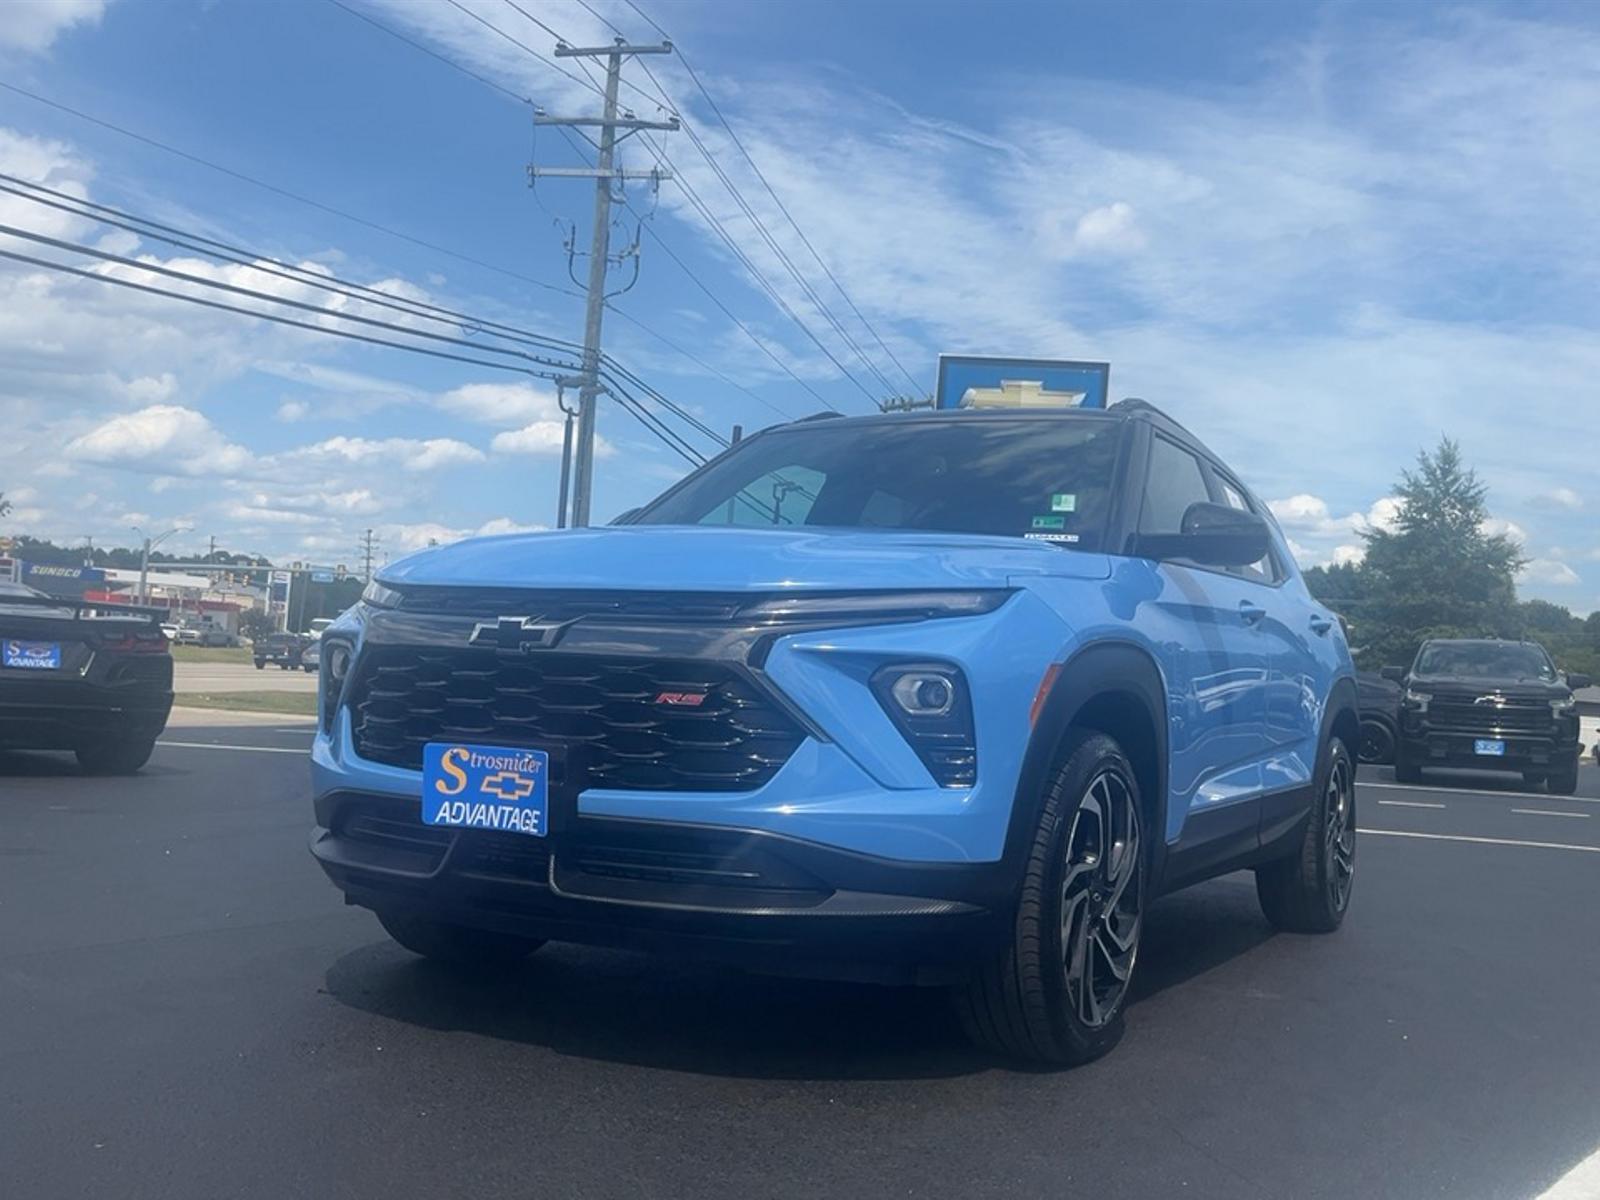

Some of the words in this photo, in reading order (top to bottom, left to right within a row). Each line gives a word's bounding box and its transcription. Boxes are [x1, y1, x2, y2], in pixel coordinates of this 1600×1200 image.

[30, 565, 81, 578] SUNOCO
[656, 693, 704, 705] RS
[435, 748, 542, 795] Strosnider
[435, 801, 541, 833] ADVANTAGE
